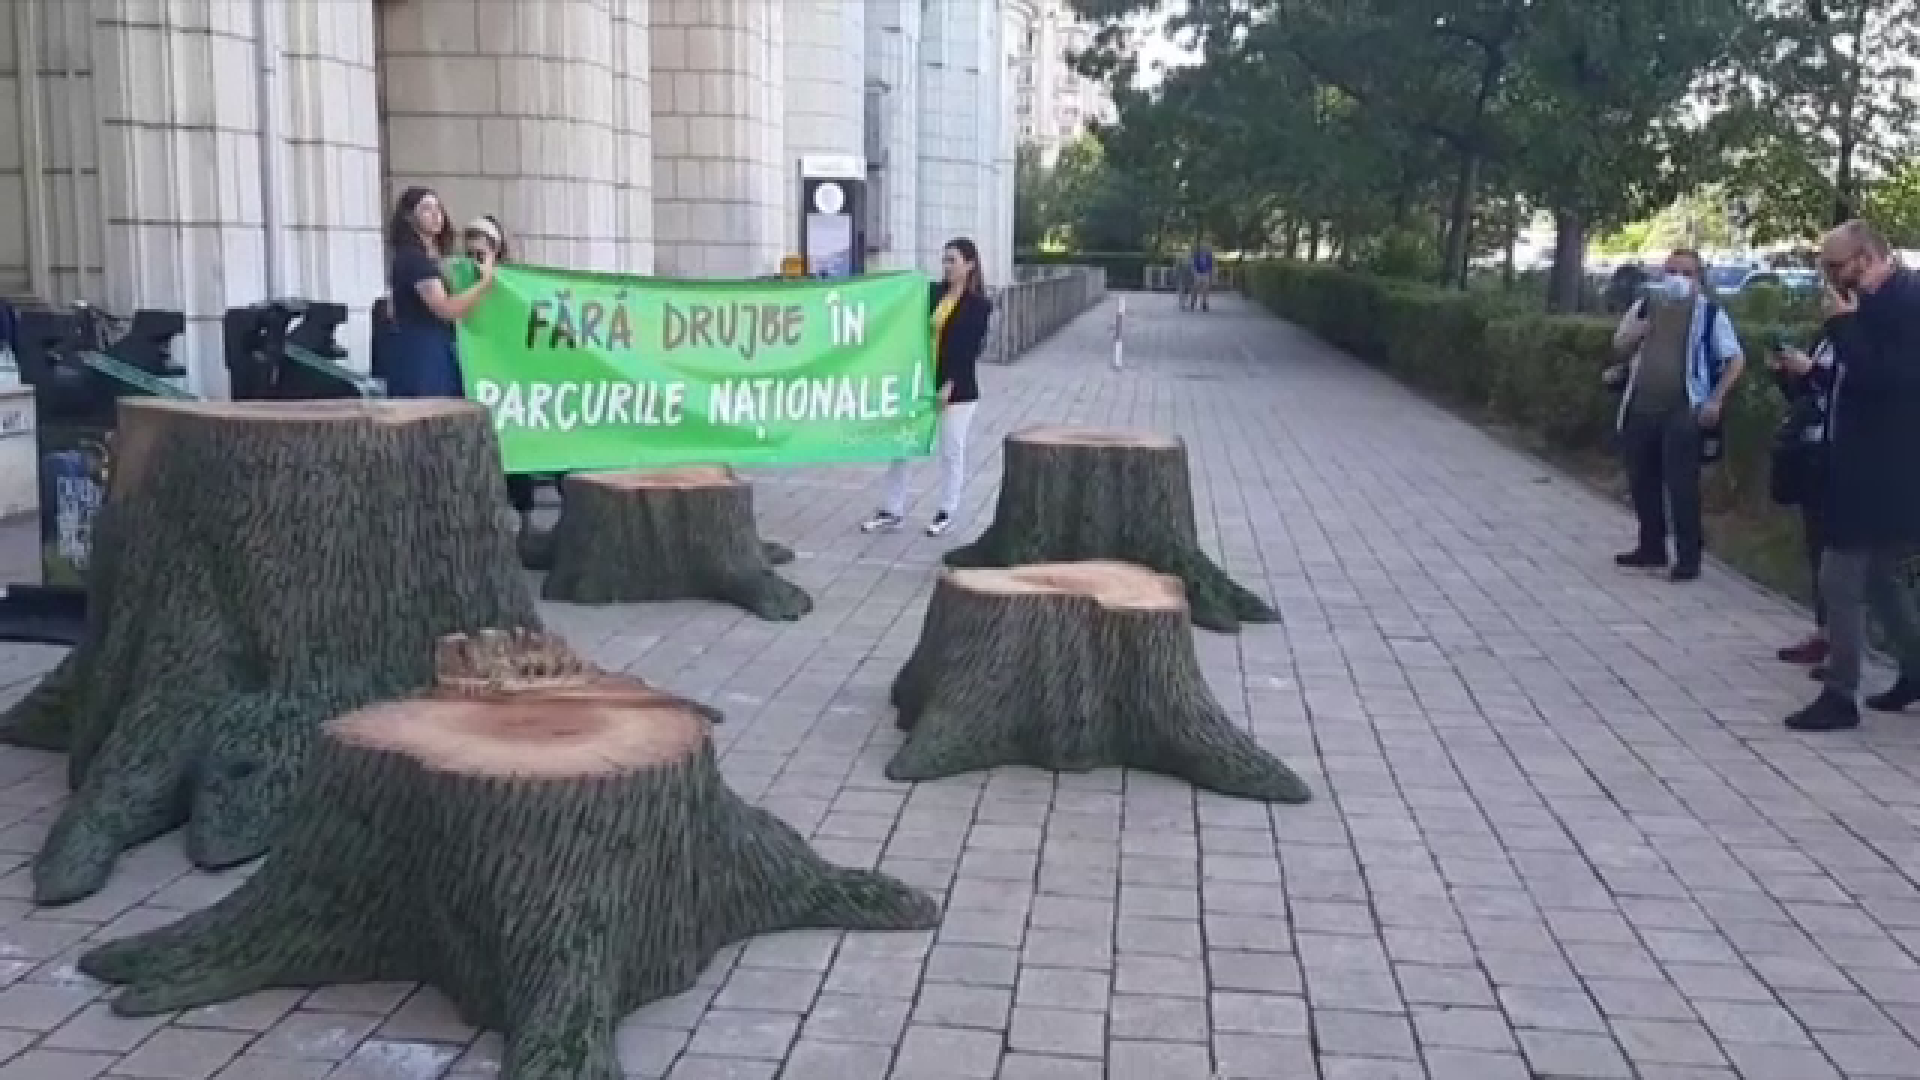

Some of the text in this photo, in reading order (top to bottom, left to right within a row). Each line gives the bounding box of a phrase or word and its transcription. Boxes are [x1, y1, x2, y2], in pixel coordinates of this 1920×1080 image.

[662, 300, 804, 360] DRUJBE
[826, 291, 865, 346] ÎN
[476, 380, 685, 431] PARCURILE
